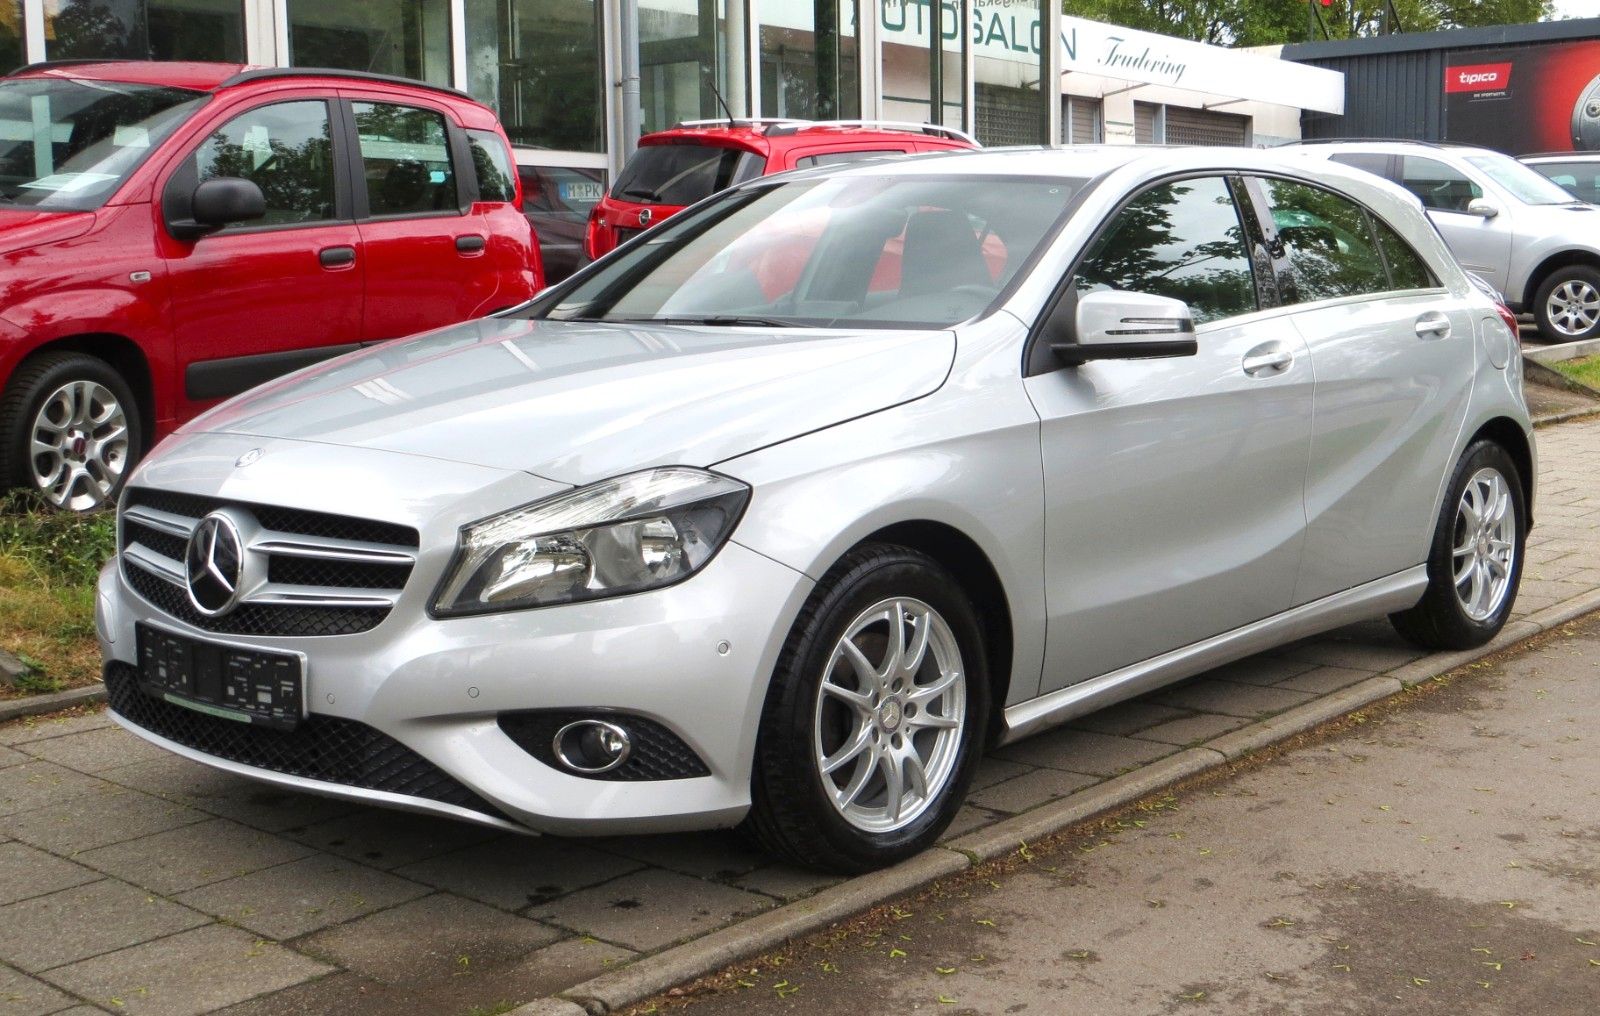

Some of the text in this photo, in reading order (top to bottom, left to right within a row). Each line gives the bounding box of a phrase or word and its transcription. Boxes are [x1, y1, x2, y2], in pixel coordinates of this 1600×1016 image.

[851, 0, 1186, 85] UTOSALON Trudering
[1459, 72, 1498, 85] tipico
